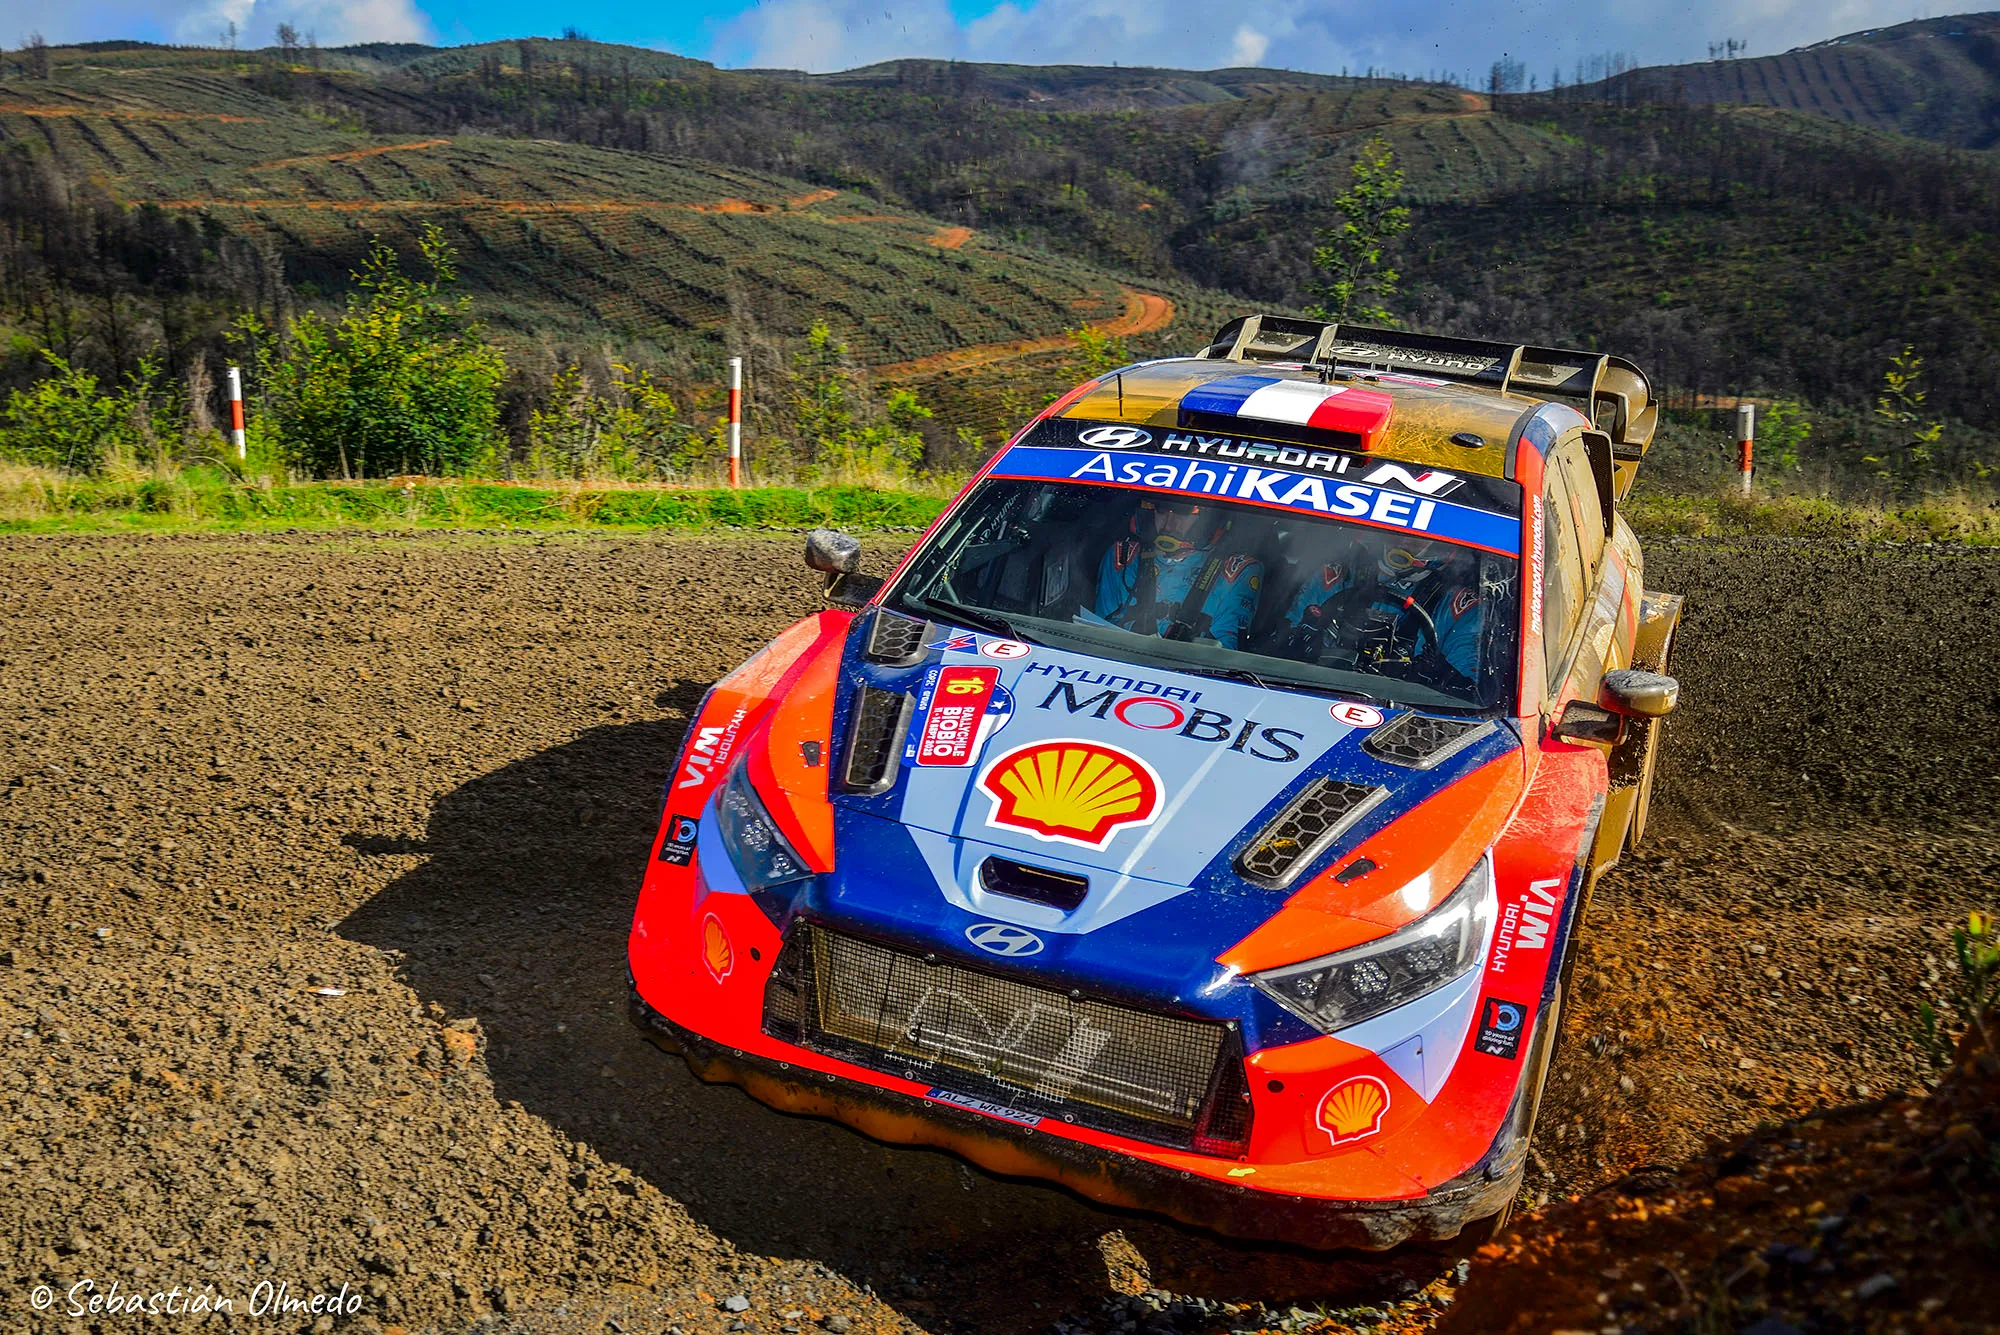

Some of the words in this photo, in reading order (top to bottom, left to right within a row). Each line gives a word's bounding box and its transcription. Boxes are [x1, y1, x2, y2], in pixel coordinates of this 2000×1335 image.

[1388, 352, 1505, 373] HYUNDA
[1162, 432, 1351, 474] HYUNDAI
[1070, 452, 1437, 531] AsahiKASEI
[1530, 494, 1543, 635] motorsport.hyundai.com
[994, 643, 1017, 655] E
[946, 677, 985, 695] 16
[1025, 661, 1203, 702] HYUNDAI
[1035, 681, 1305, 763] MOBIS
[1344, 707, 1368, 721] E
[715, 708, 748, 766] HYUNDAI
[1491, 902, 1521, 973] HYUNDAI
